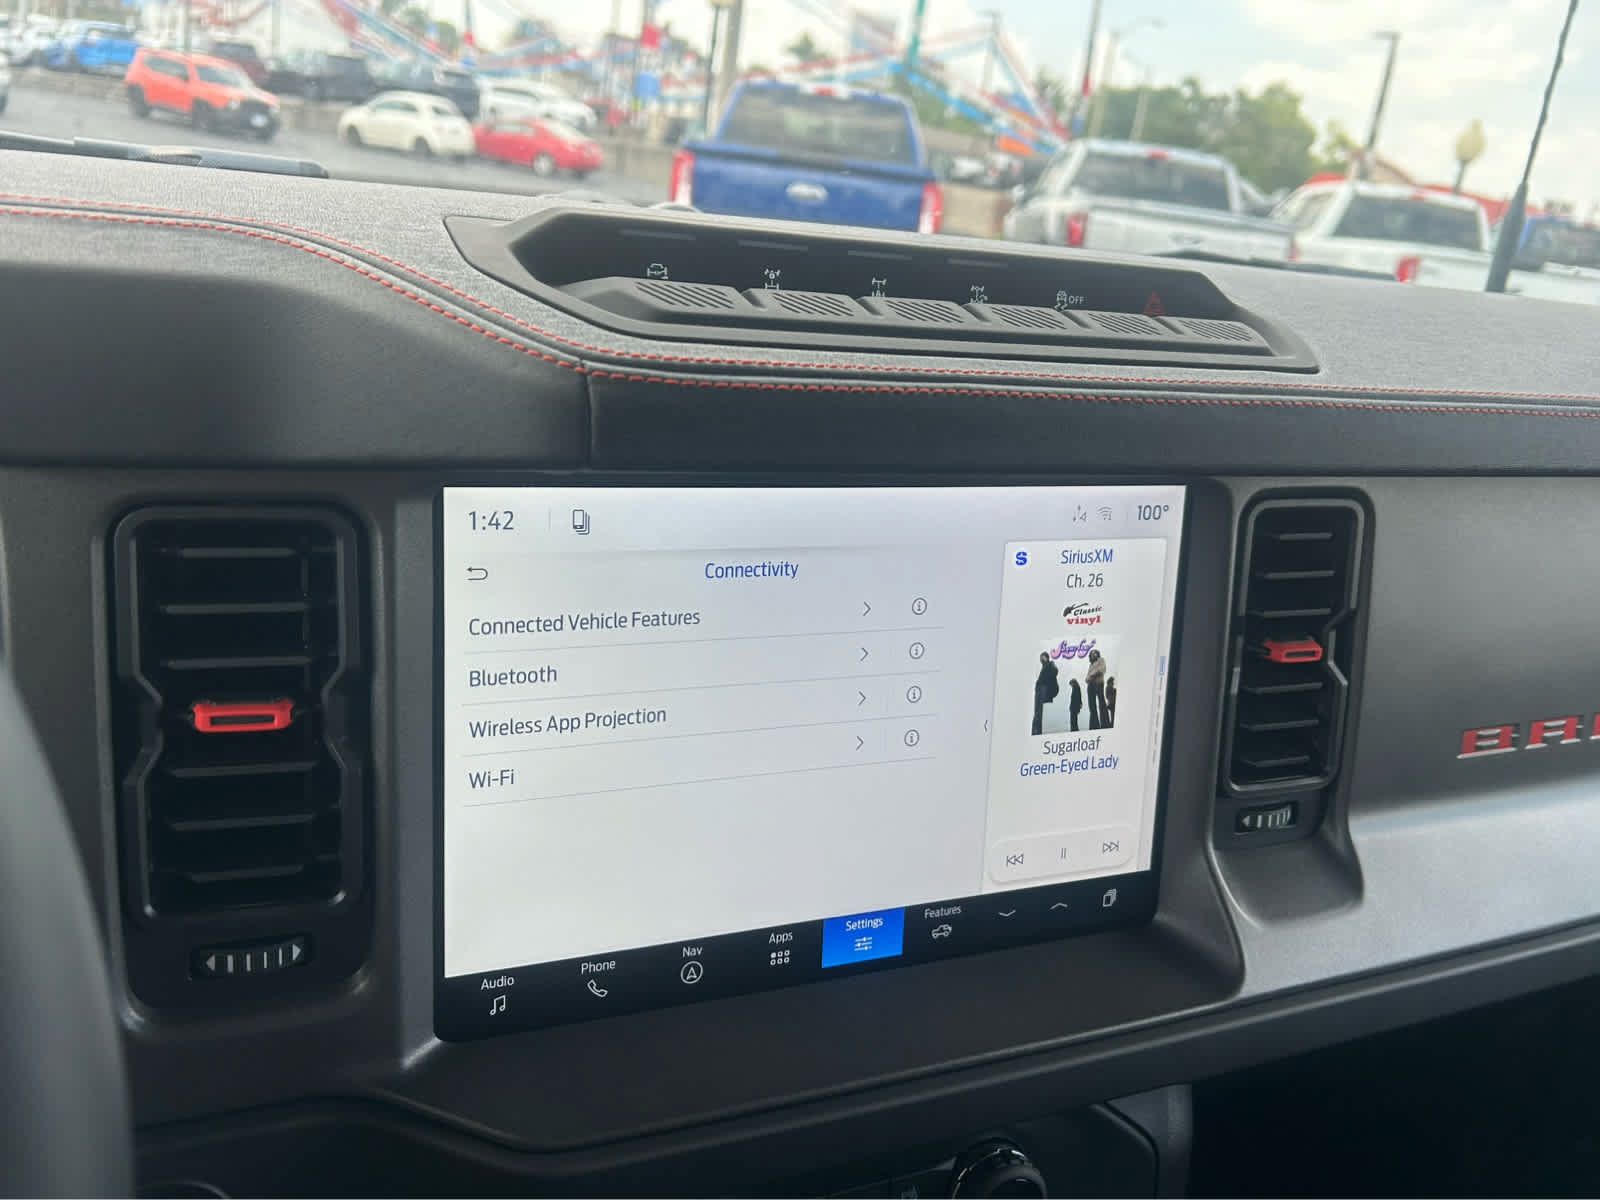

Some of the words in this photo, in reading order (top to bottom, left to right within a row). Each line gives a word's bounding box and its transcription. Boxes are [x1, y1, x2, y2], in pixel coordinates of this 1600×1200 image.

[1068, 295, 1085, 305] OFF
[468, 510, 515, 531] 1:42
[1061, 549, 1114, 565] SiriusXM
[704, 561, 800, 580] Connectivity
[1066, 573, 1085, 588] Ch.
[1087, 573, 1104, 587] 26
[468, 614, 564, 636] Connected
[568, 611, 628, 631] Vehicle
[631, 609, 701, 628] Features
[468, 665, 558, 687] Bluetooth
[468, 719, 543, 739] Wireless
[546, 715, 581, 734] App
[584, 707, 667, 730] Projection
[1043, 737, 1102, 756] Sugarloaf
[1020, 756, 1089, 777] Green-Eyed
[1091, 754, 1119, 770] Lady
[468, 769, 515, 789] Wi-Fi
[924, 904, 962, 919] Features
[845, 917, 884, 932] Settings
[768, 931, 793, 945] Apps
[682, 946, 703, 958] Nav
[580, 958, 617, 975] Phone
[480, 975, 515, 991] Audio
